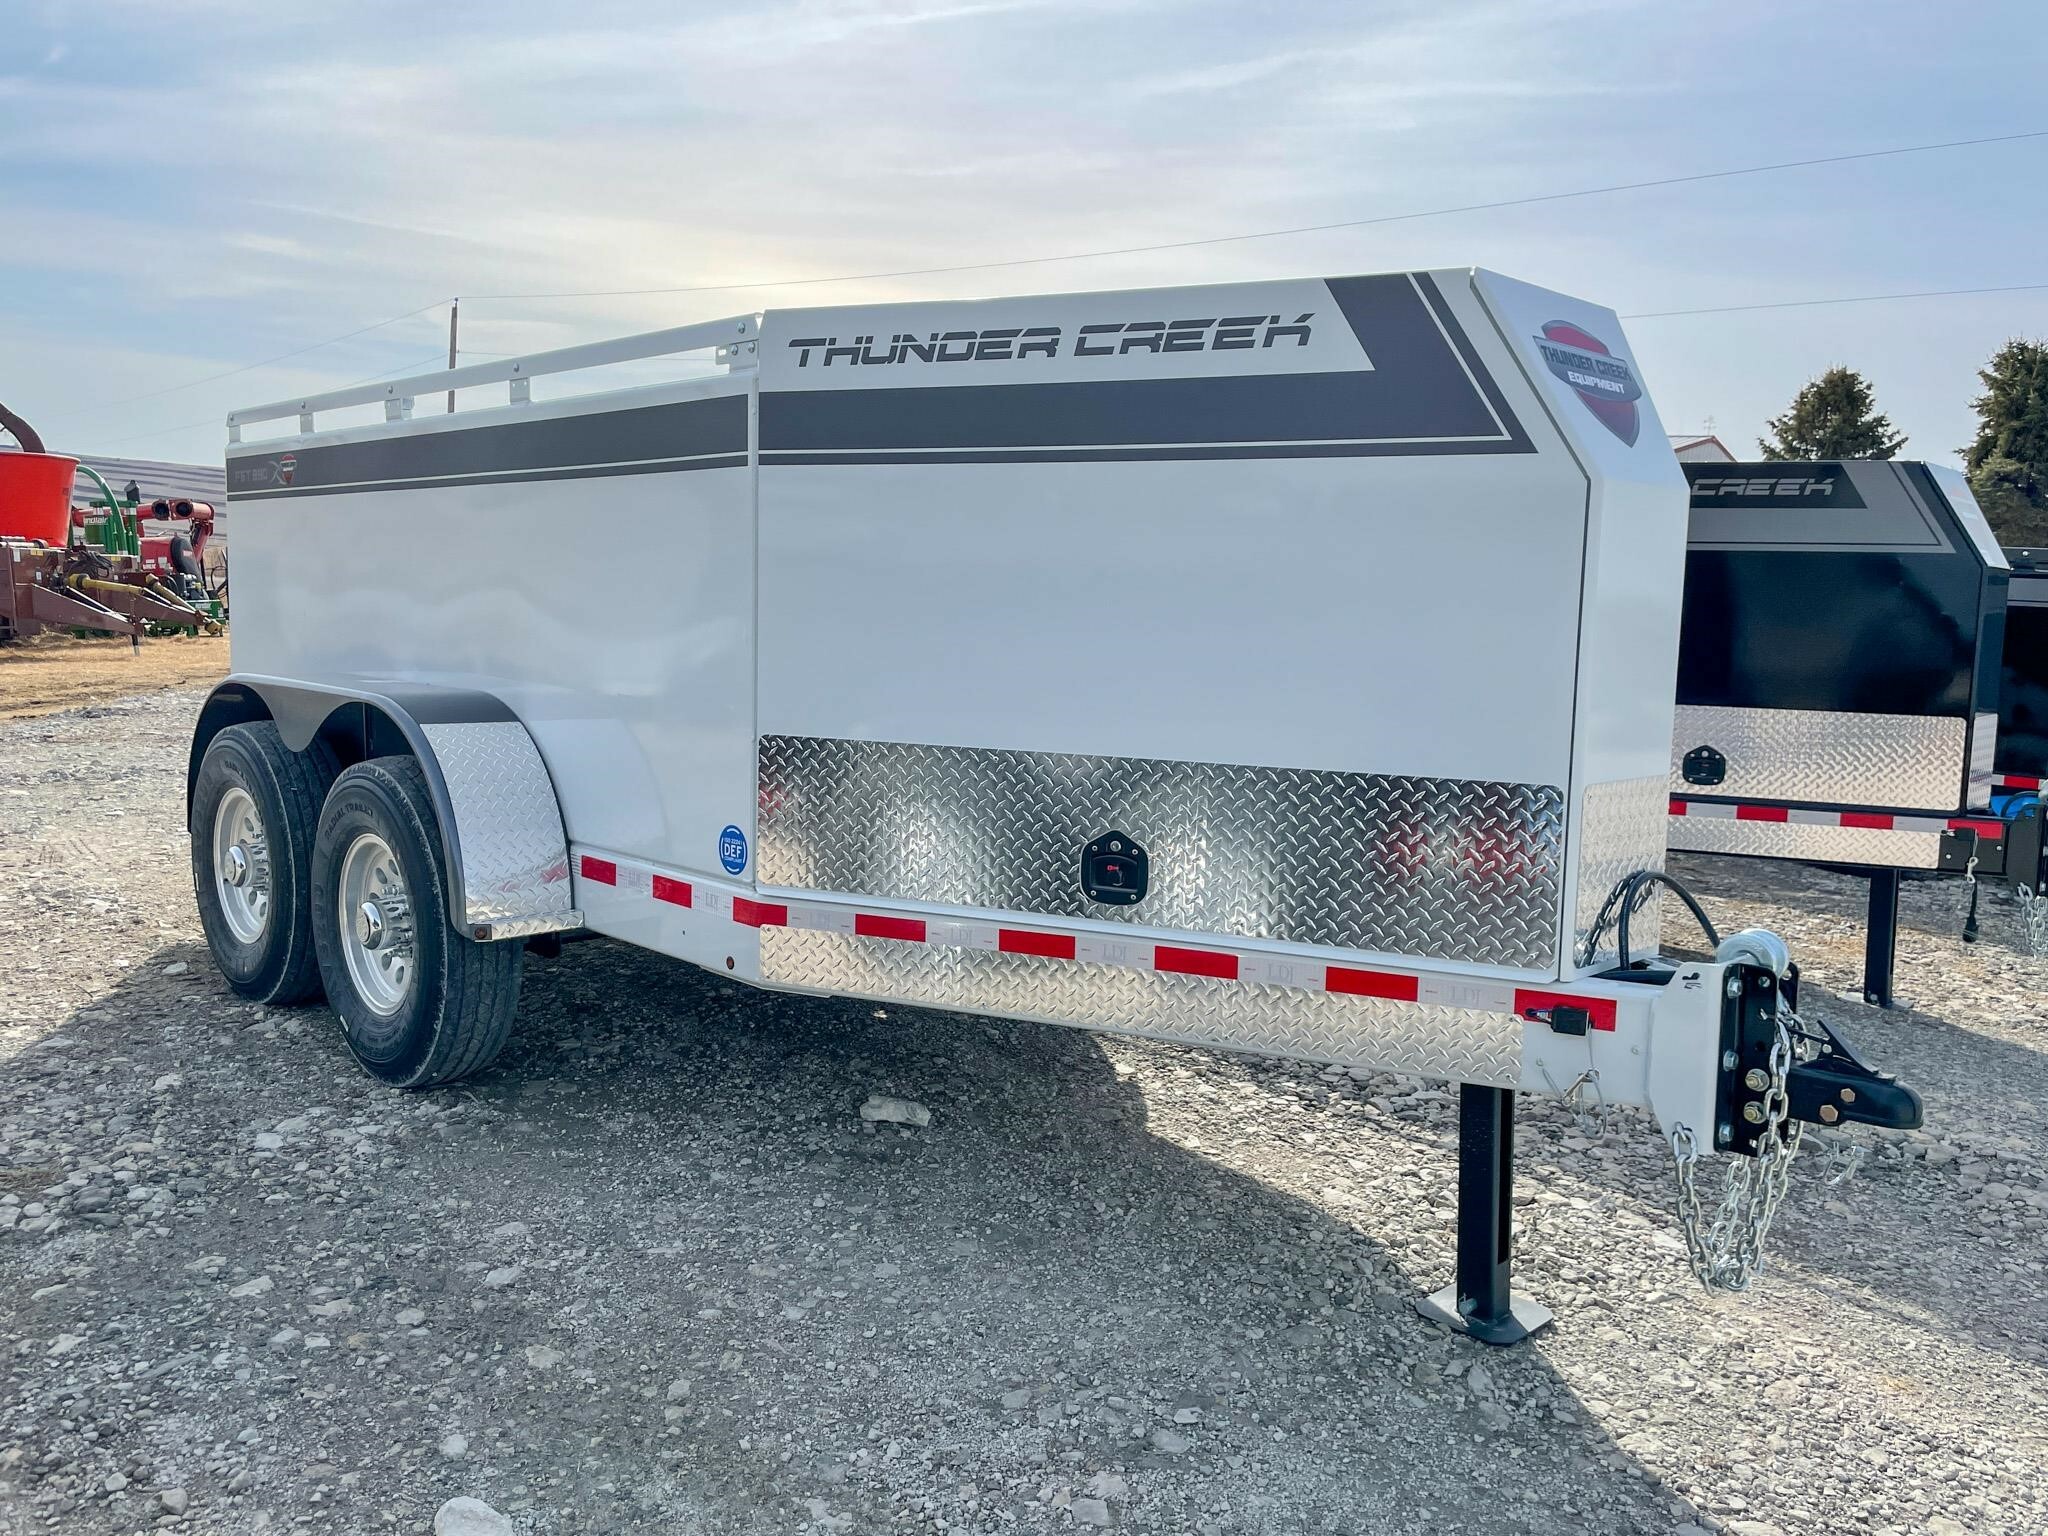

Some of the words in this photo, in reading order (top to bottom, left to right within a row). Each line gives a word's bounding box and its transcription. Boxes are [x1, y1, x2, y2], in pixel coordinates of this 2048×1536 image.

[788, 326, 1061, 367] THUNDER
[1073, 312, 1316, 358] CREEK
[1540, 344, 1597, 373] THUNDER
[1594, 358, 1633, 382] CREEK
[1567, 370, 1626, 394] EQUIPMENT
[1690, 477, 1835, 497] CREEK
[724, 843, 743, 859] DEF
